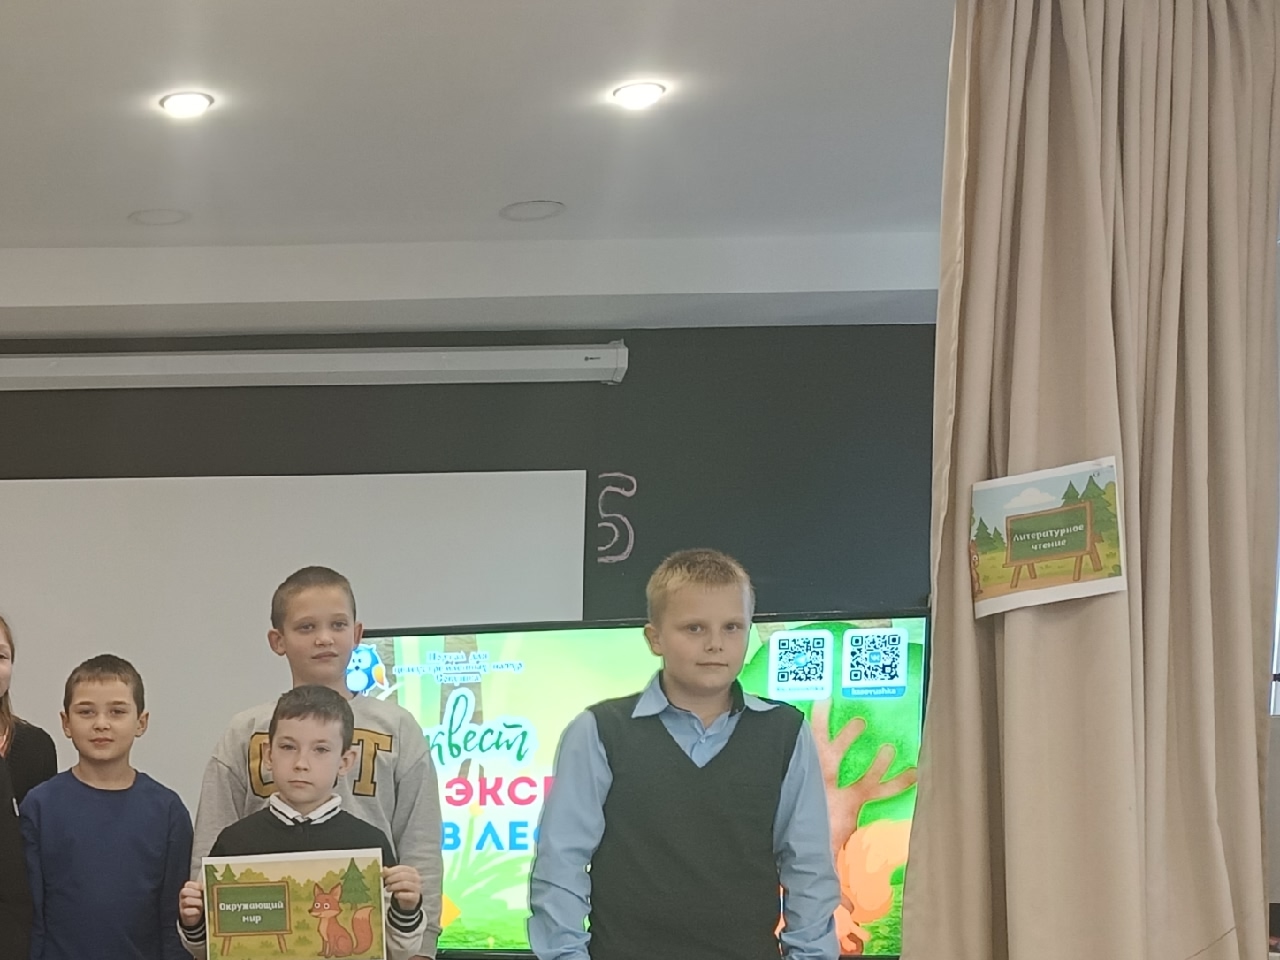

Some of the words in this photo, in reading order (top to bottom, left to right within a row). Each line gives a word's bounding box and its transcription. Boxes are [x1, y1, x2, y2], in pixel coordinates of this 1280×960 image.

[1013, 524, 1084, 541] Литературное
[1031, 539, 1067, 550] чтение
[475, 821, 540, 850] ЛЕ
[219, 901, 284, 911] Окружающий
